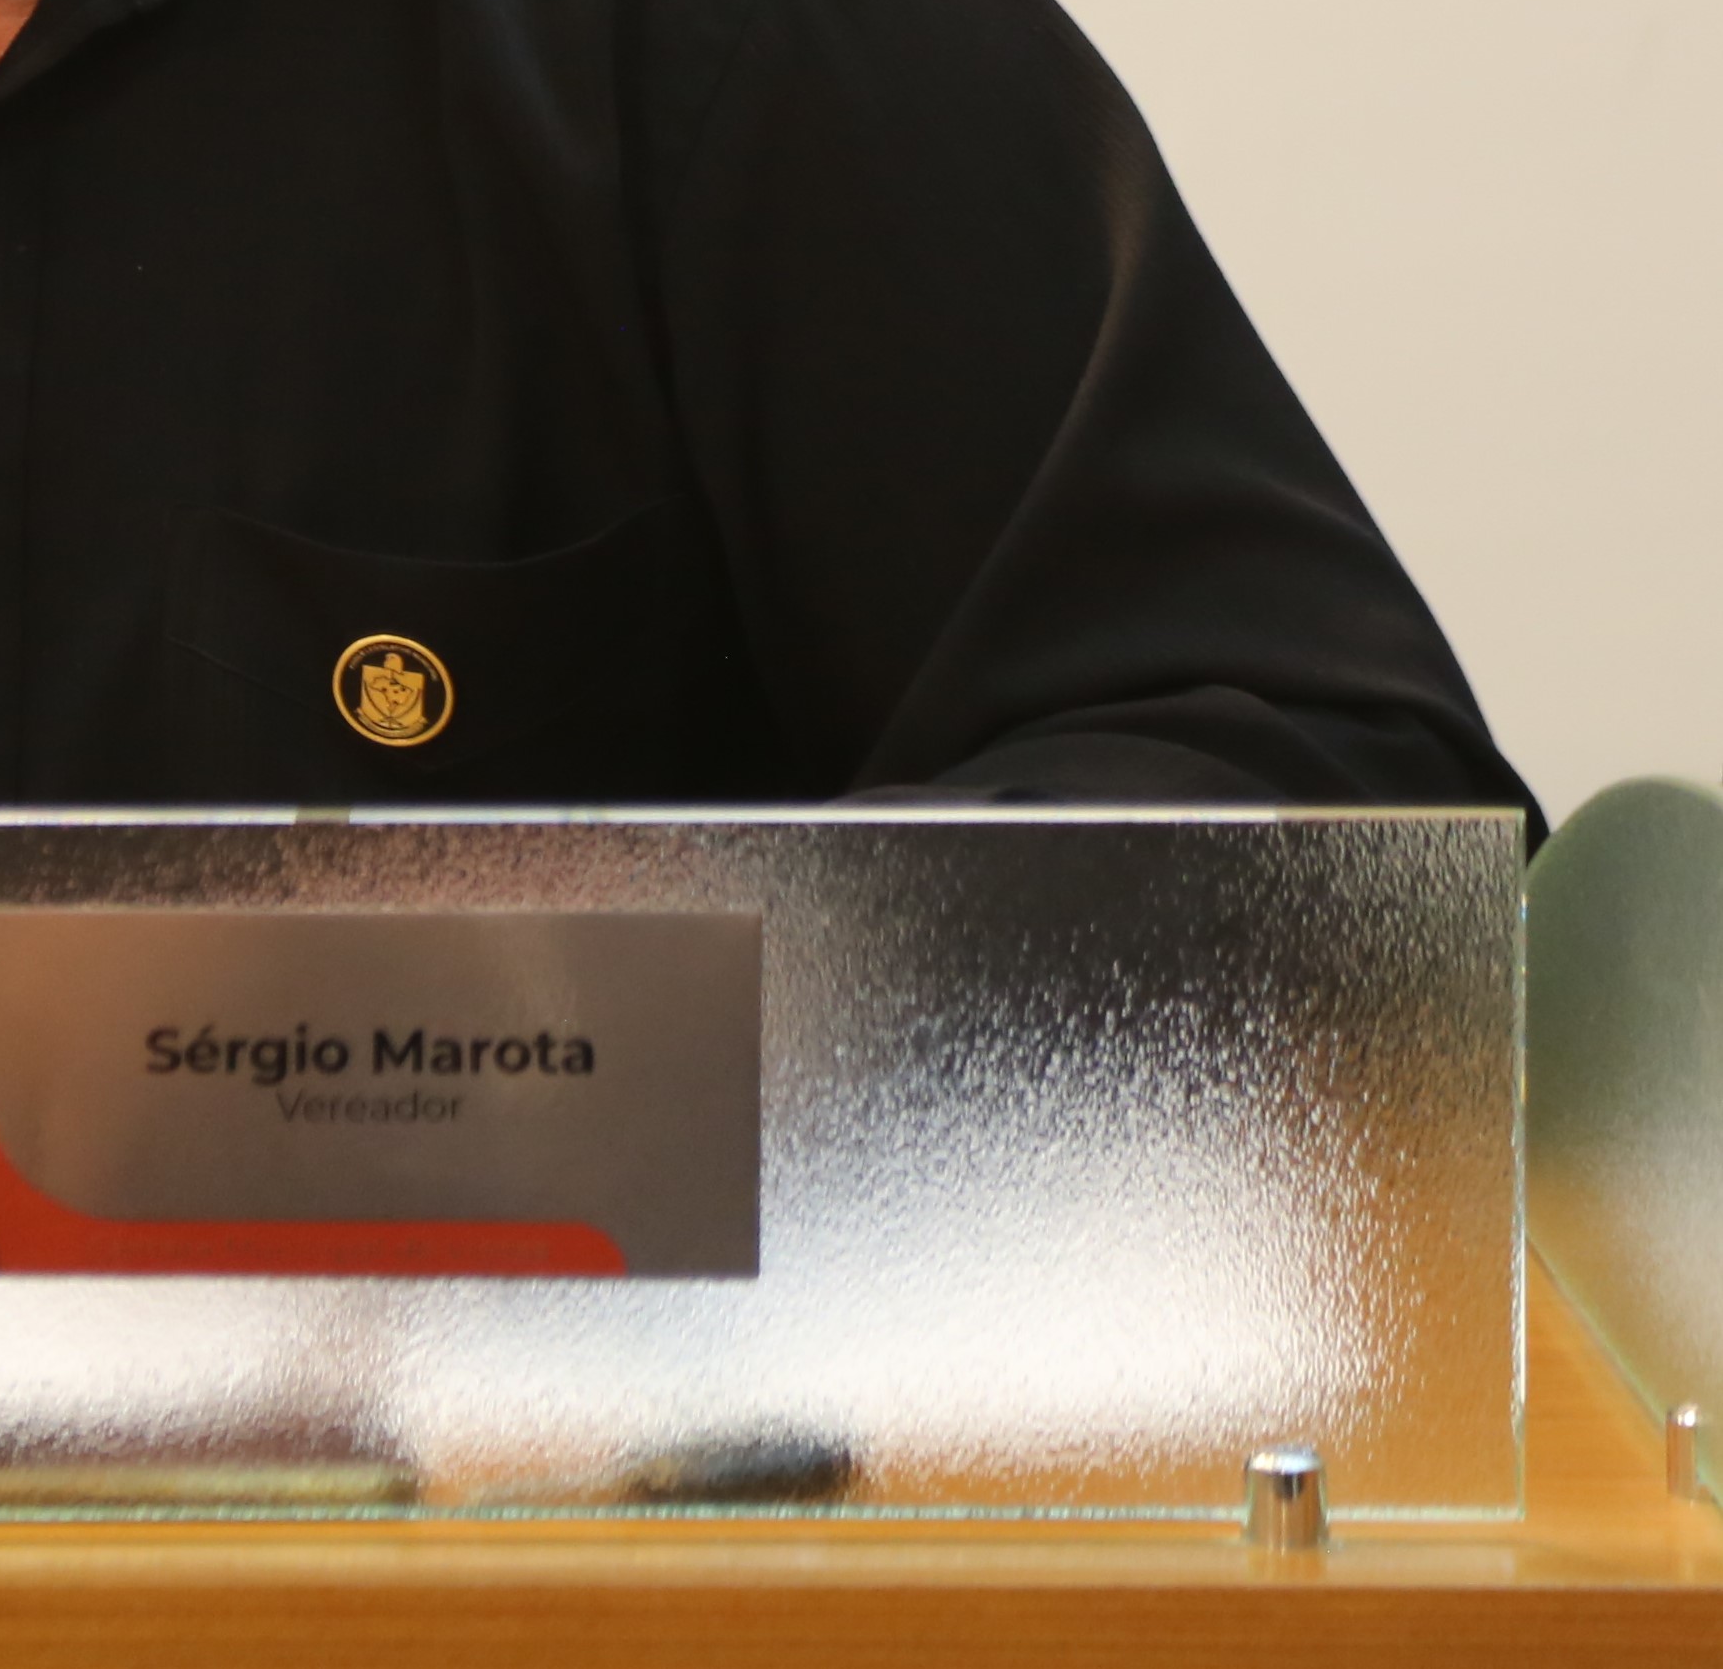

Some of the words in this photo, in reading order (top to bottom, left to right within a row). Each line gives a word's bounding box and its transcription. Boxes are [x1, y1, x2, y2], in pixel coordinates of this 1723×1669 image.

[146, 1024, 349, 1085] Sérgio
[372, 1027, 595, 1075] Marota
[277, 1089, 463, 1123] Vereador
